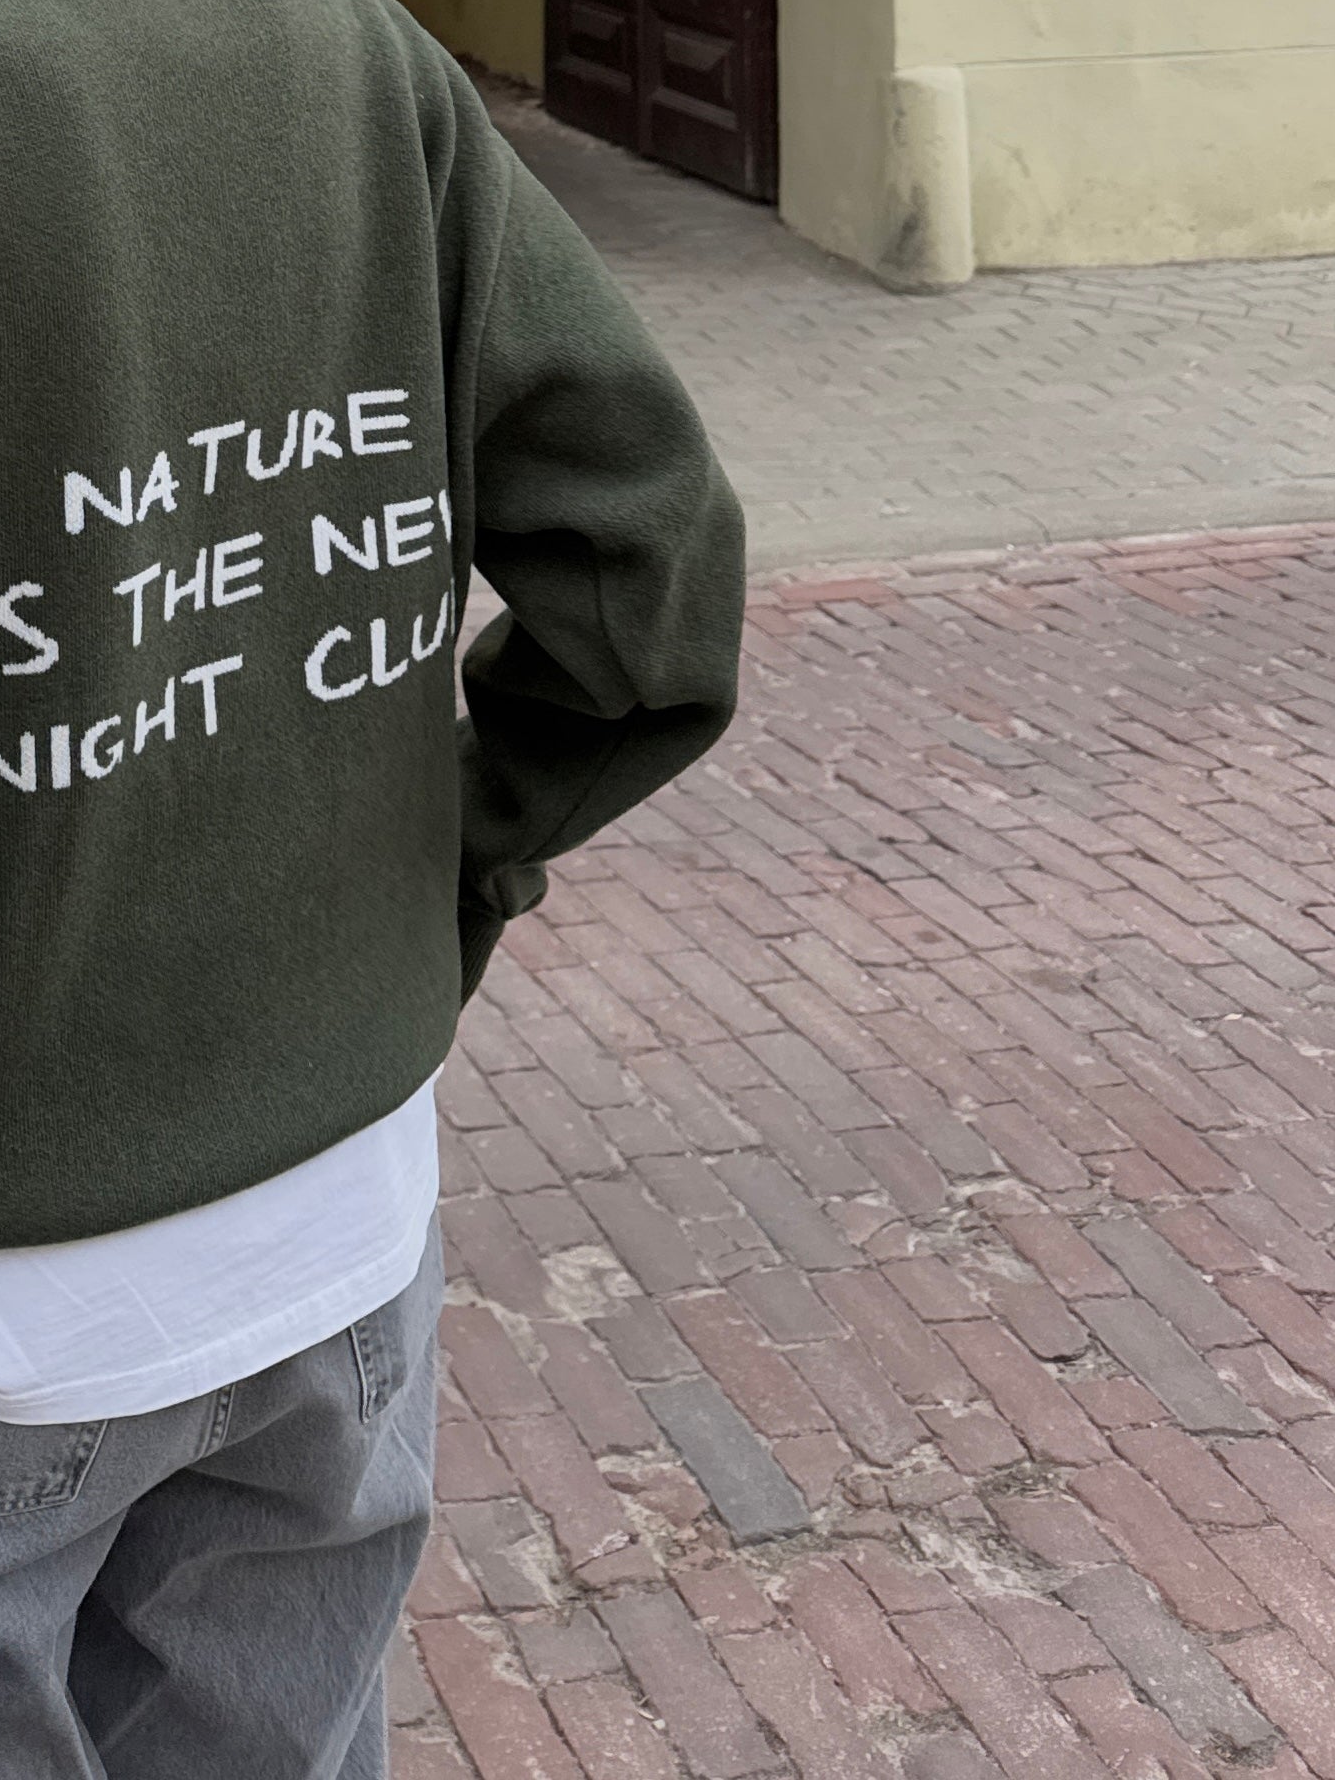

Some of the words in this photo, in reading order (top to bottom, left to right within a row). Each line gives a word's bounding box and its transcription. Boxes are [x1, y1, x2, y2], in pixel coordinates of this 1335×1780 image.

[64, 388, 413, 535] NATURE
[112, 531, 264, 647] THE
[303, 577, 456, 702] CLU
